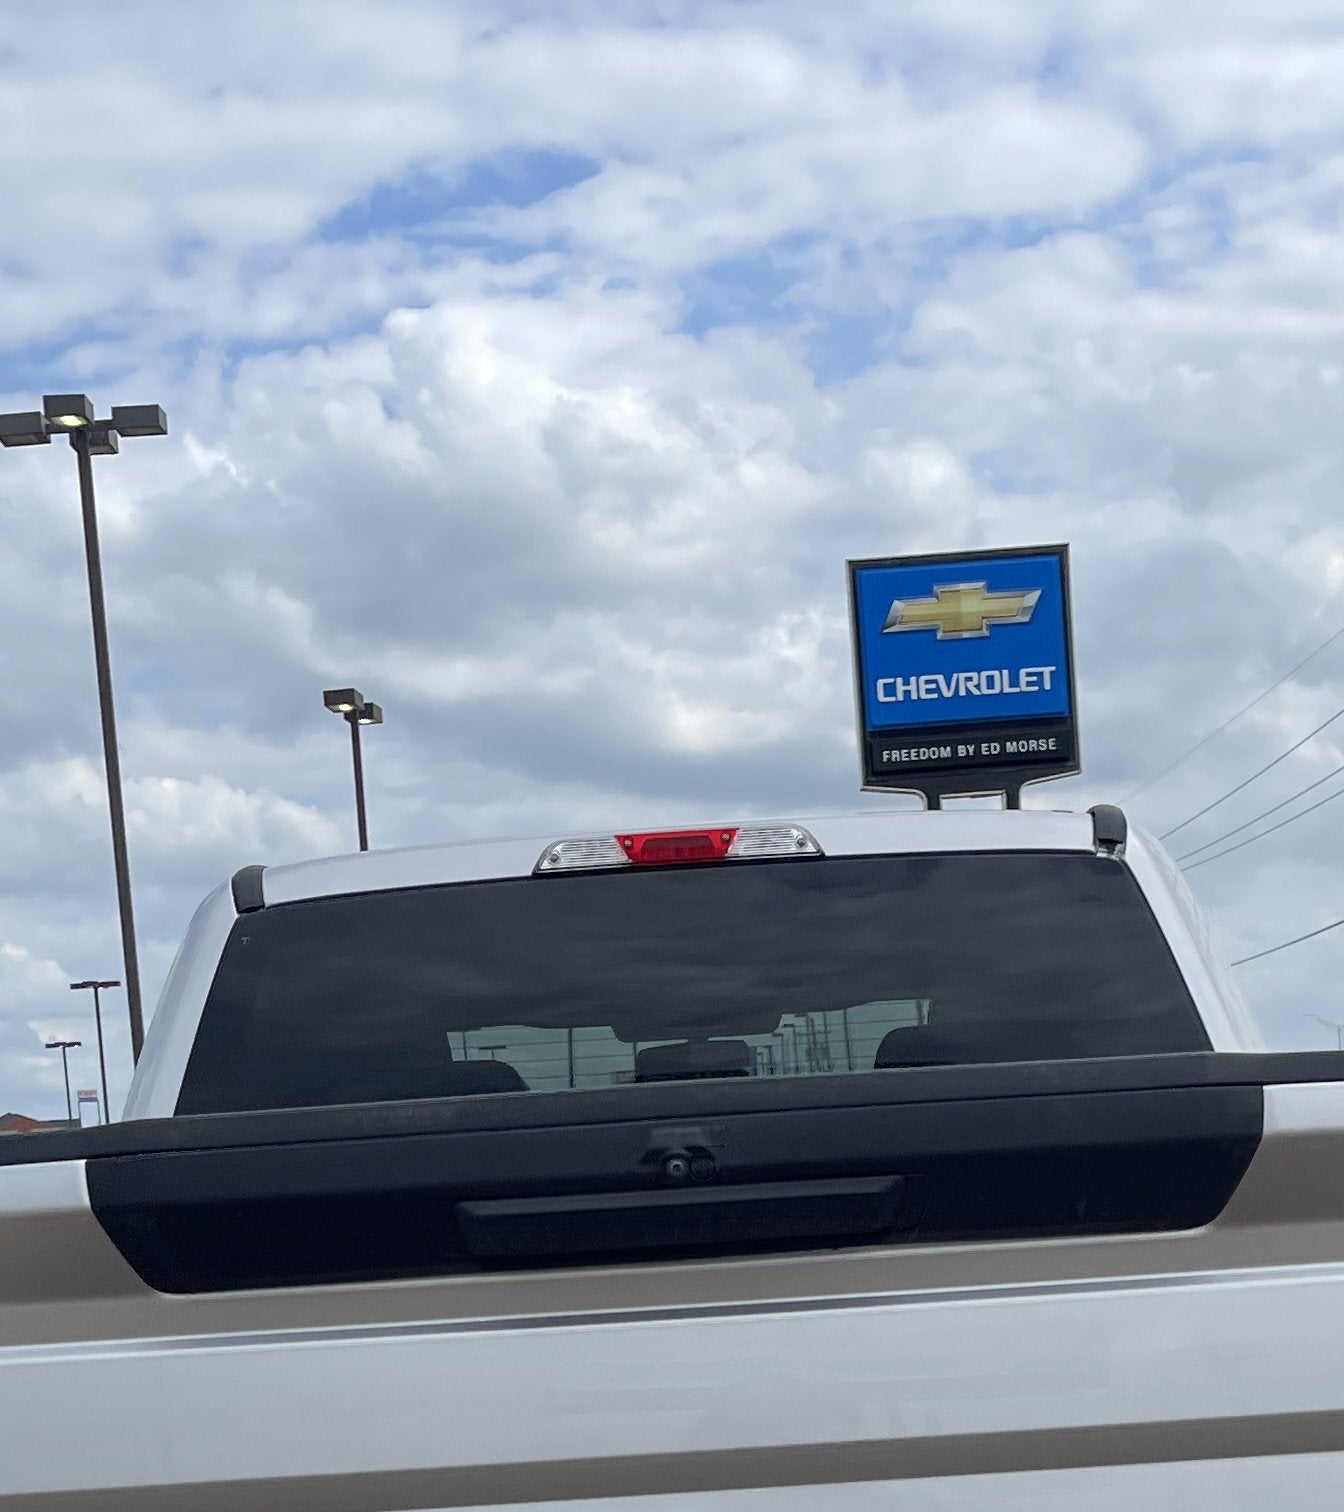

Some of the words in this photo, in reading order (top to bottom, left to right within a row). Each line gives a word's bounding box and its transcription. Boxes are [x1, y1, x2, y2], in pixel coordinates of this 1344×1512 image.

[876, 666, 1057, 703] CHEVROLET
[882, 745, 952, 763] FREEDOM
[957, 744, 976, 757] BY
[981, 742, 1001, 756] ED
[1006, 737, 1057, 753] MORSE
